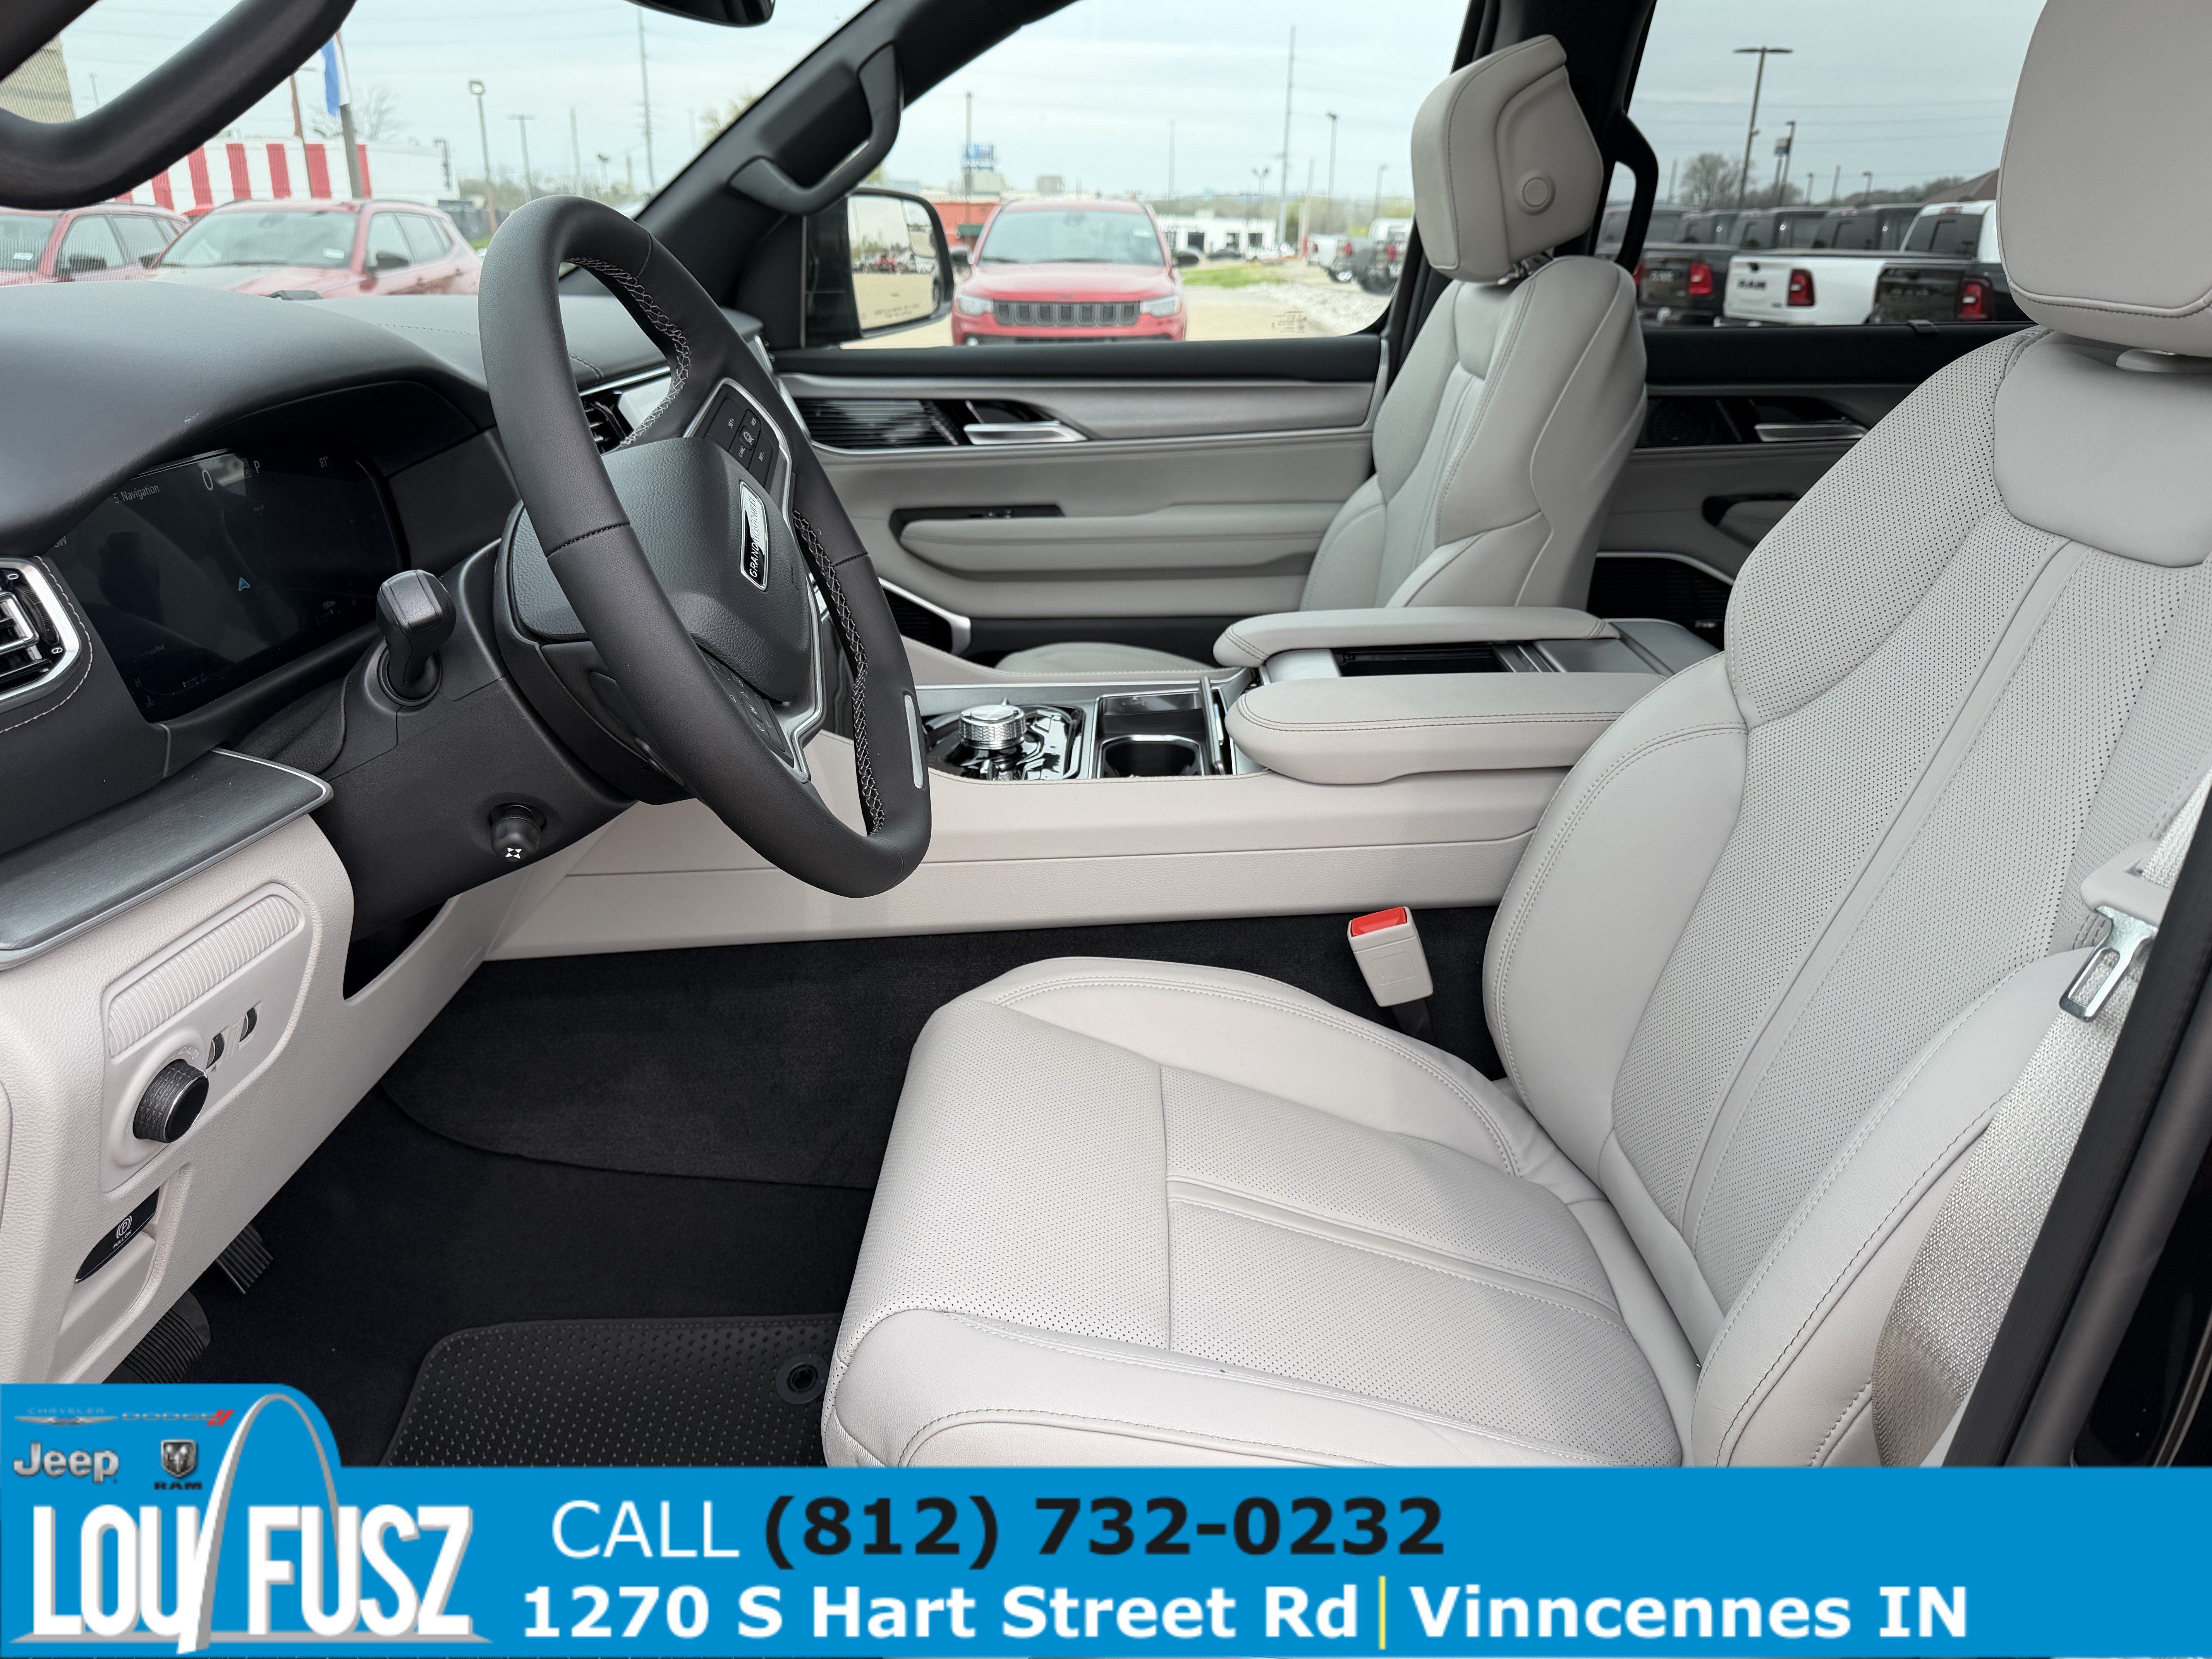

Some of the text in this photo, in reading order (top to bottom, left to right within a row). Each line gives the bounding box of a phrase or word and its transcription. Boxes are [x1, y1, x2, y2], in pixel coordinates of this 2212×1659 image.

[254, 460, 260, 474] P
[202, 469, 213, 491] 0
[749, 542, 759, 578] GRAND
